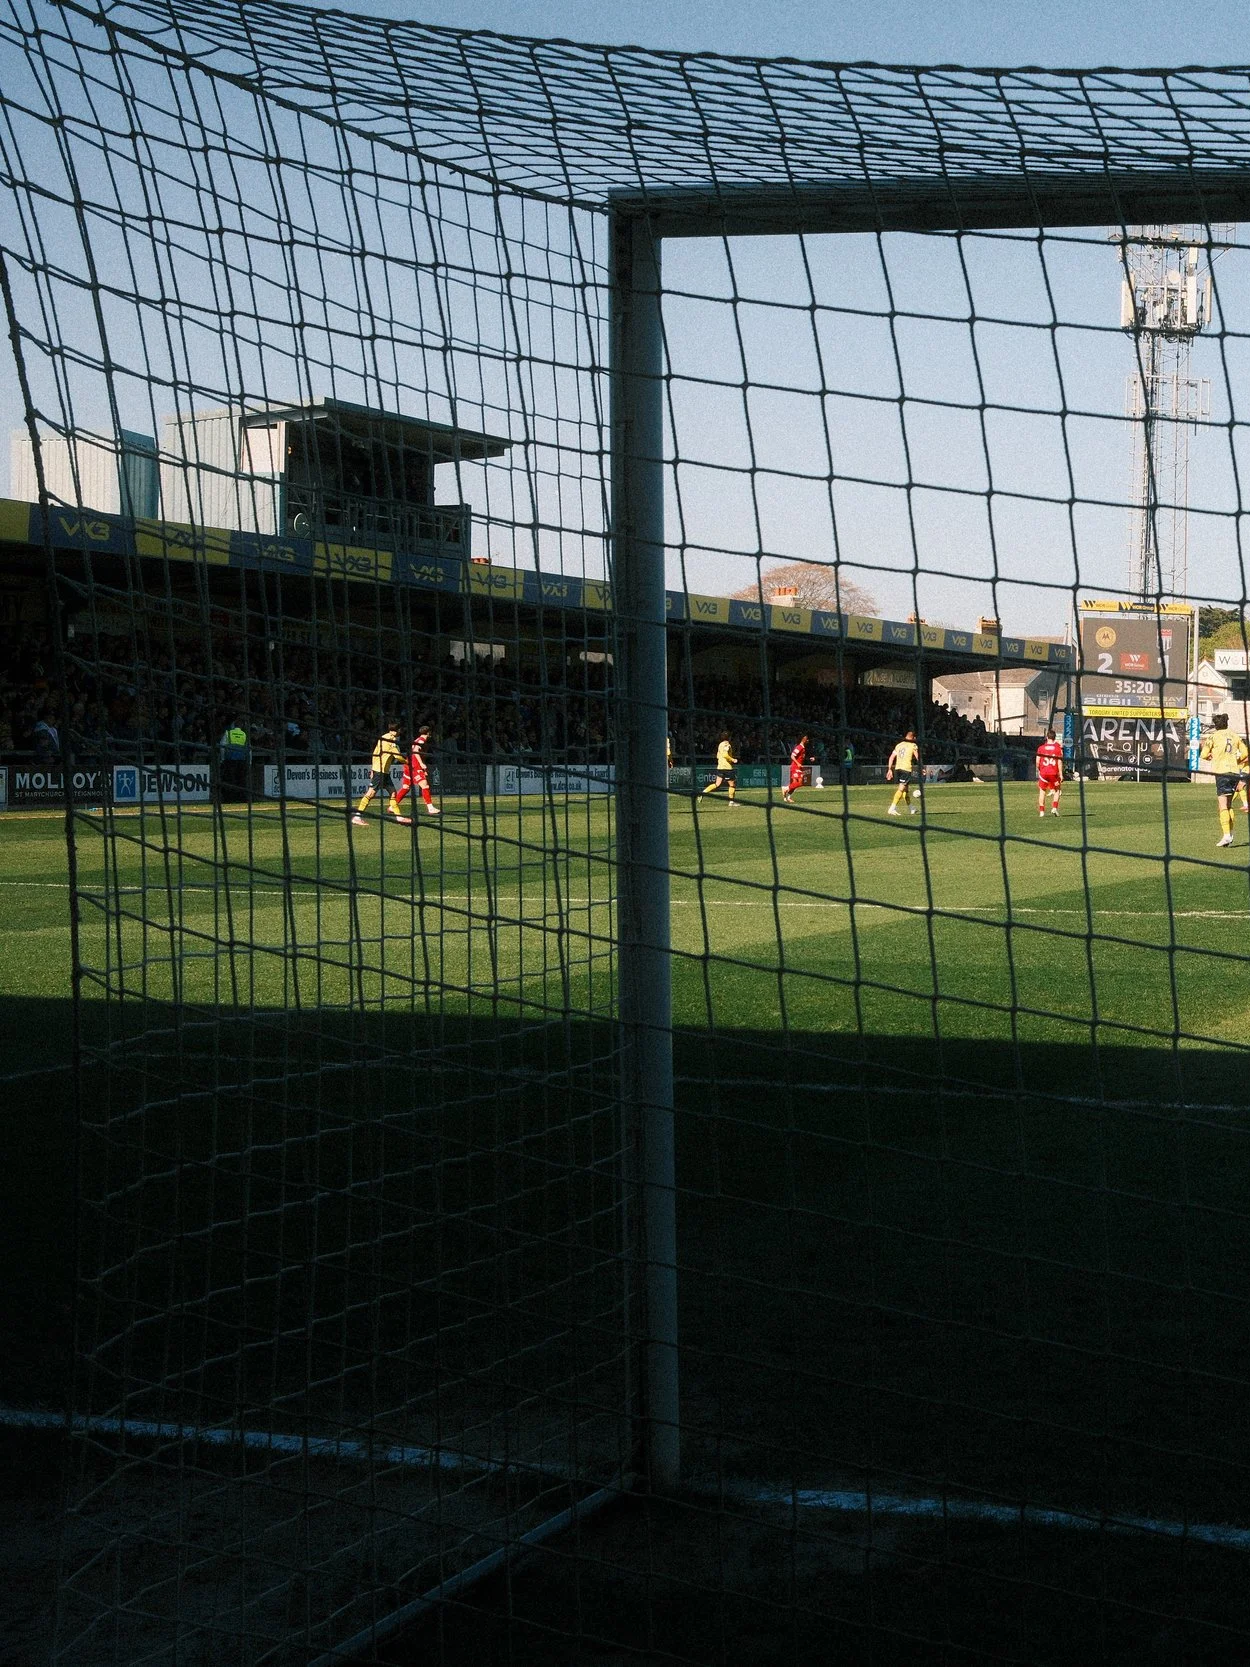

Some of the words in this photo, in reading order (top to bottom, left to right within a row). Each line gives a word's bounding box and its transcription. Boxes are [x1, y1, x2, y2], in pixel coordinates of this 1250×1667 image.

[695, 600, 718, 616] VX3
[741, 606, 765, 620] VX3
[782, 611, 800, 625] VX3
[820, 617, 840, 630] VX3
[856, 622, 874, 634] VX3
[890, 627, 906, 639] VX3
[922, 632, 937, 642] VX3
[952, 634, 966, 646] VX3
[980, 638, 992, 648] VX3
[1005, 642, 1019, 652] VX3
[1030, 645, 1042, 655] VX3
[1054, 648, 1066, 658] VX3
[1096, 652, 1112, 673] 2
[1156, 654, 1168, 677] 1
[1114, 680, 1153, 693] 35:20
[1082, 718, 1180, 742] ARENA
[1225, 738, 1233, 753] 5
[1042, 756, 1056, 767] 34
[286, 768, 311, 780] Devon's
[312, 769, 338, 780] Bsiness
[358, 770, 362, 780] &
